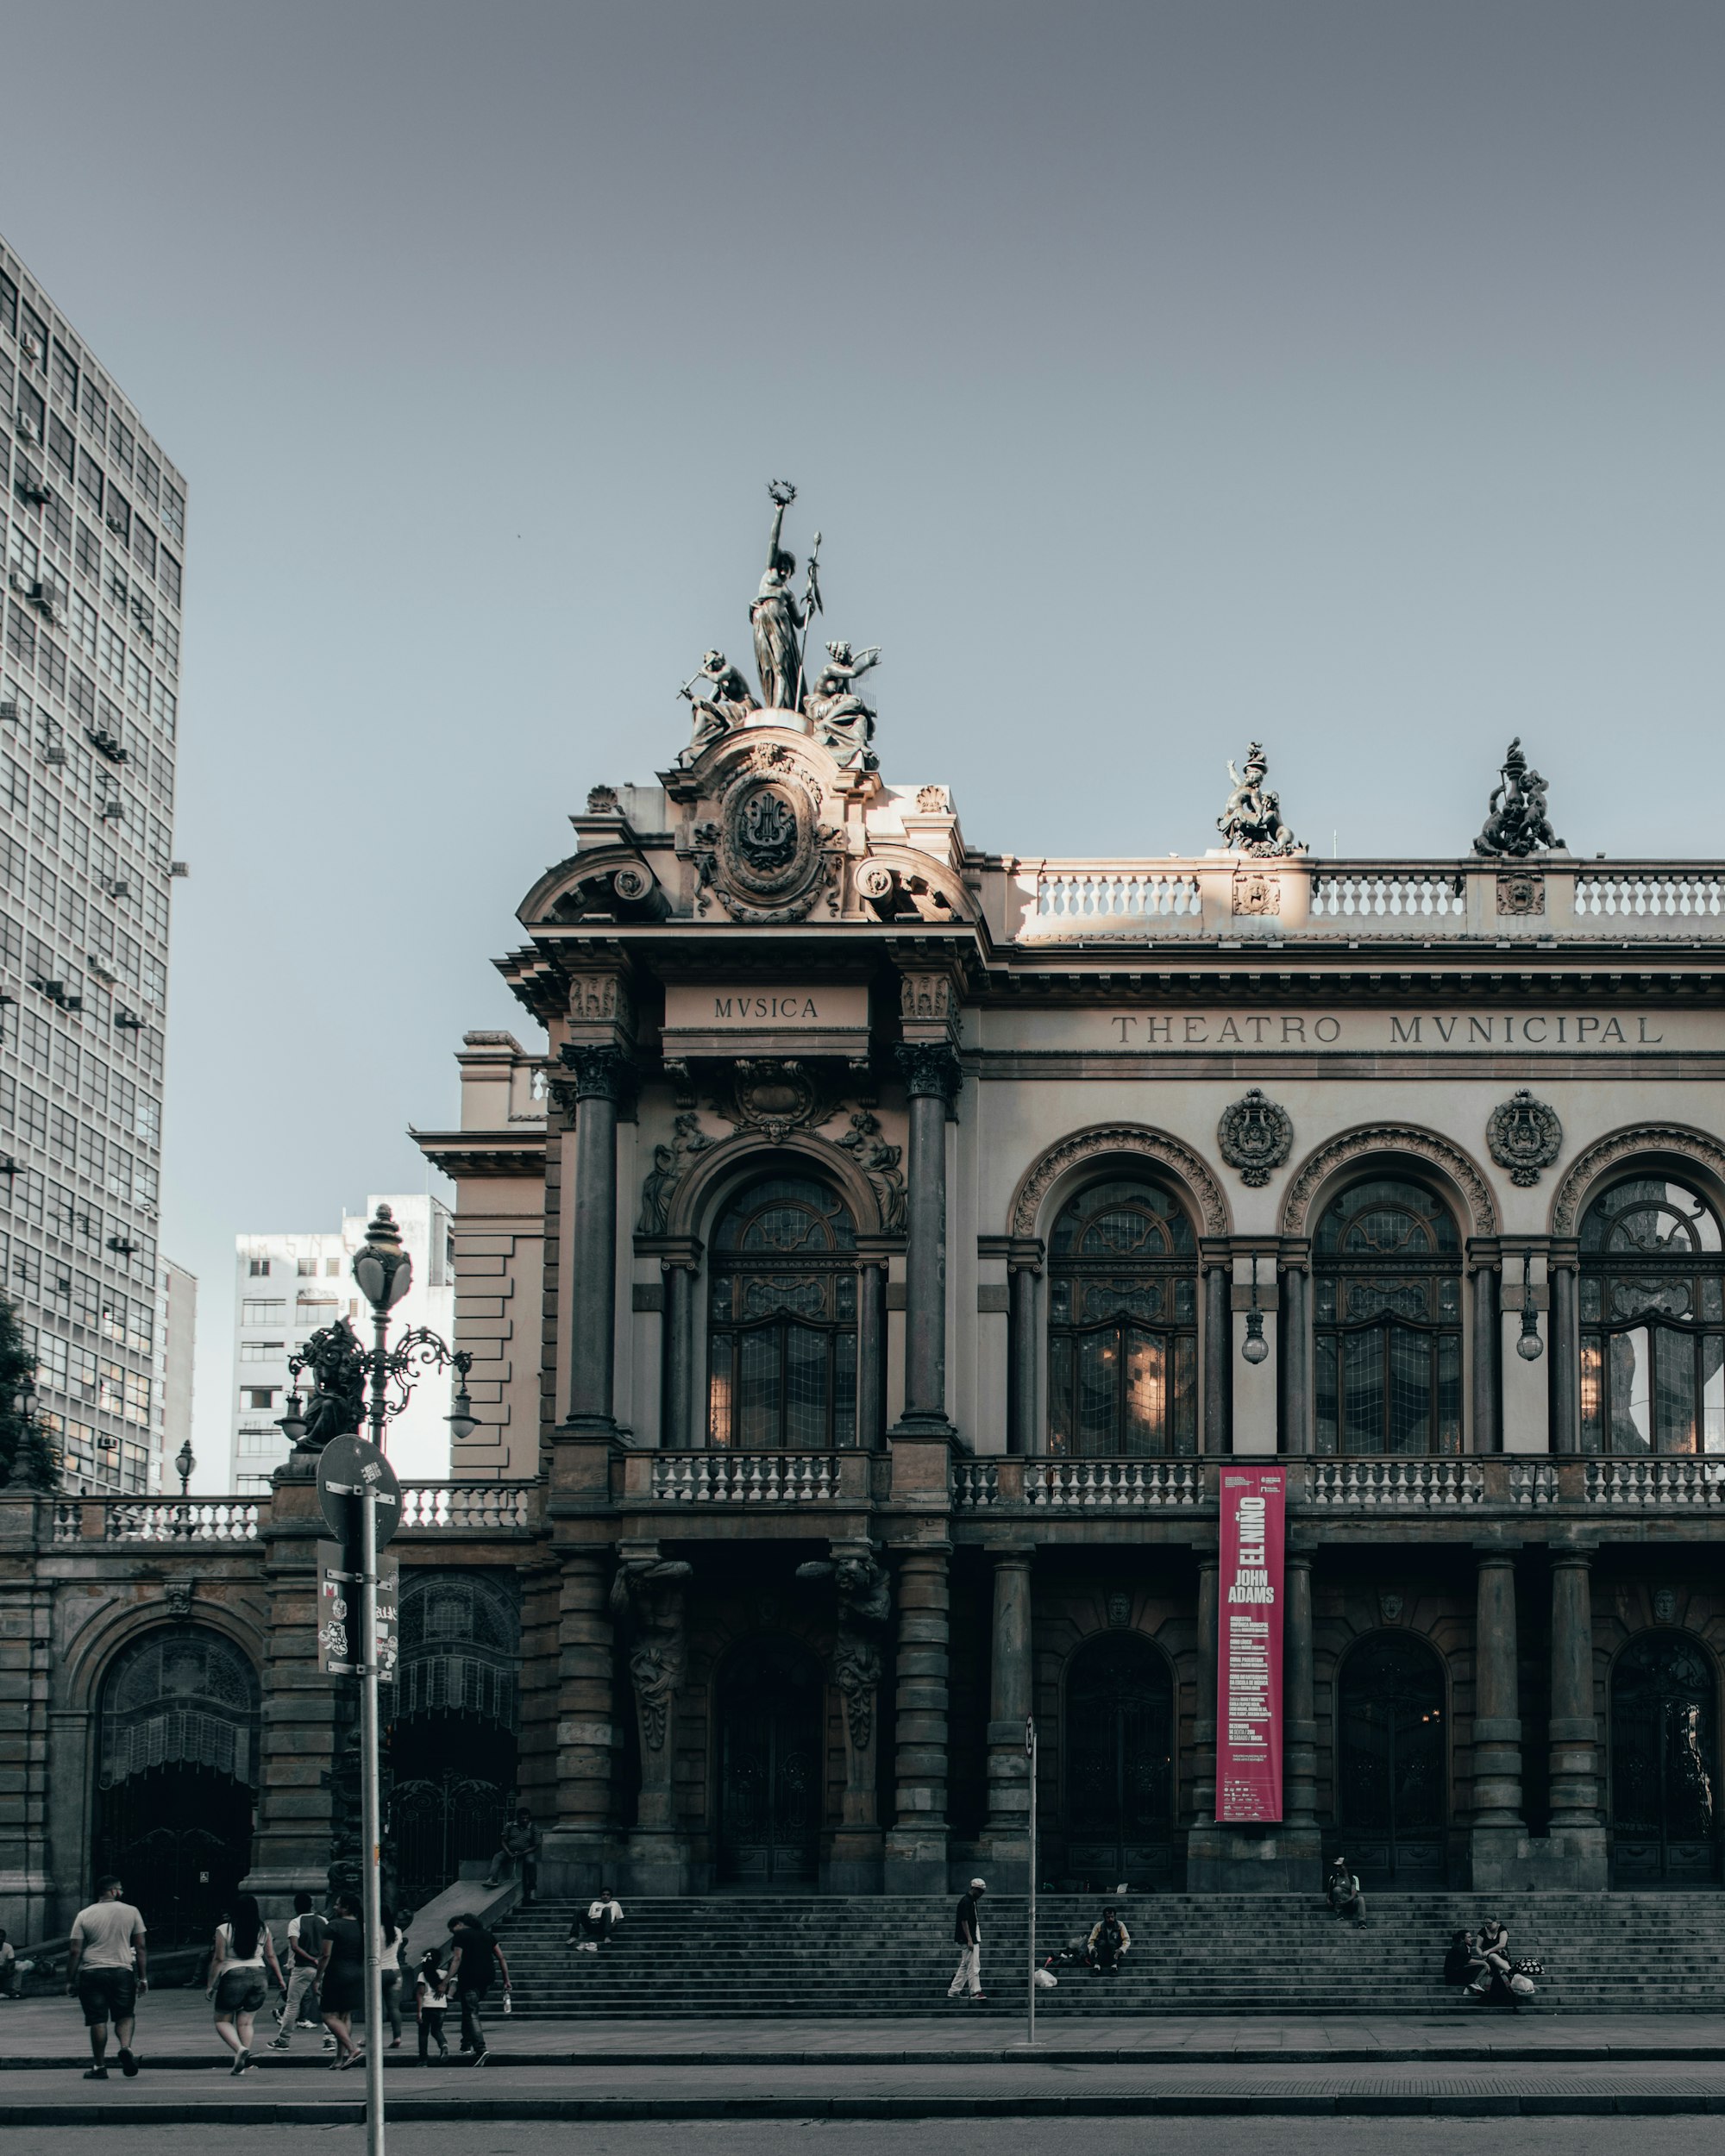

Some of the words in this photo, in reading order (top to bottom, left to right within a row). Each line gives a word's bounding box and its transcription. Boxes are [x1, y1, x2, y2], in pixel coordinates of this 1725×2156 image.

[714, 998, 819, 1018] MVSICA
[1111, 1016, 1341, 1044] THEATRO
[1389, 1016, 1664, 1044] MVNICIPAL
[1235, 1496, 1266, 1543] NIÑO
[1239, 1545, 1265, 1565] EL
[1235, 1570, 1268, 1587] JOHN
[1228, 1587, 1275, 1604] ADAMS
